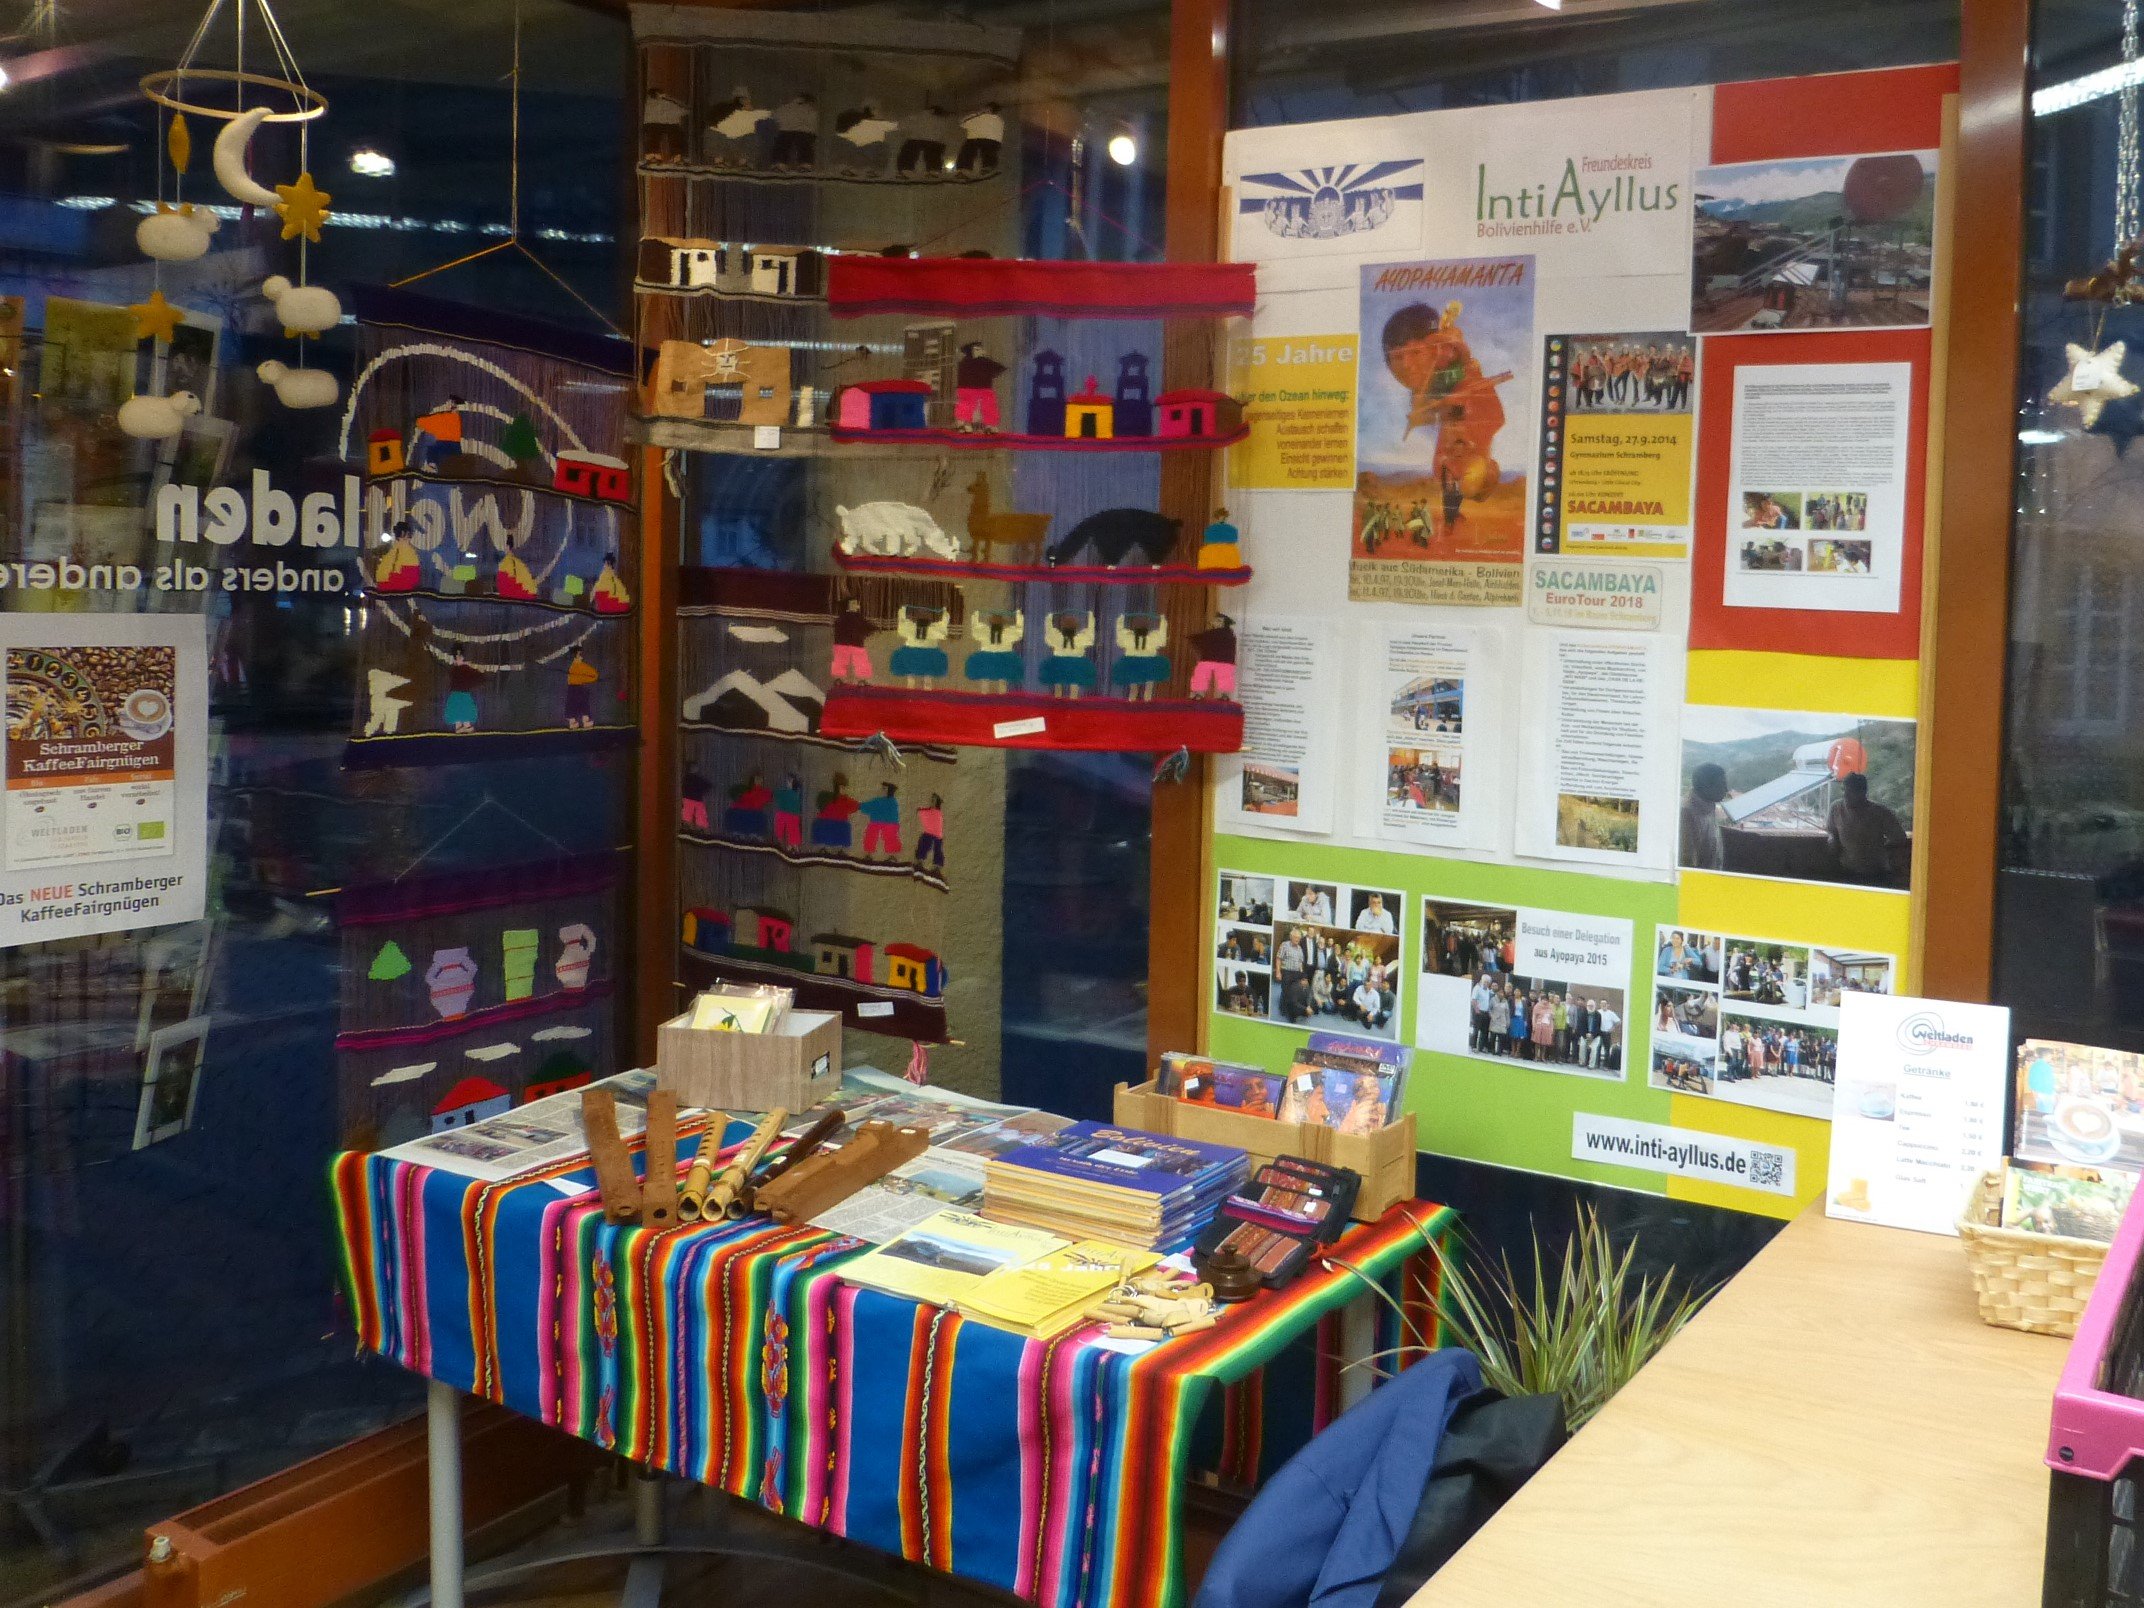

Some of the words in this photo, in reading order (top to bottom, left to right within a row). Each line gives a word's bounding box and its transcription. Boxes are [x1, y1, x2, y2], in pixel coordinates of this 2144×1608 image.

[1582, 153, 1652, 172] Freundeskreis
[1477, 220, 1562, 237] Bolivienhilfe
[1277, 343, 1353, 365] Jahre
[1259, 390, 1277, 402] den
[1279, 389, 1309, 402] Ozean
[1571, 433, 1622, 445] Samstag,
[1626, 435, 1677, 446] 27.9.2014
[1570, 452, 1614, 460] Gymnasium
[1616, 451, 1661, 460] Schramberg
[1568, 500, 1664, 515] SACAMBAYA
[1381, 564, 1398, 572] aus
[1401, 562, 1464, 577] Südamerika
[1477, 566, 1520, 578] Bolivien
[1535, 569, 1656, 594] SACAMBAYA
[1546, 592, 1606, 608] EuroTour
[1610, 596, 1643, 609] 2018
[39, 739, 144, 756] Schramberger
[23, 754, 159, 772] KaffeeFairgnügen
[31, 825, 87, 837] WELTLADEN
[30, 884, 73, 901] NEUE
[78, 874, 183, 898] Schramberger
[21, 893, 160, 923] KaffeeFairgnügen
[1522, 922, 1550, 937] Besuch
[1552, 928, 1573, 940] einer
[1575, 929, 1621, 946] Delegation
[1534, 948, 1548, 958] aus
[1550, 948, 1584, 965] Ayopaya
[1587, 952, 1607, 965] 2015
[1912, 1023, 1973, 1045] Weltladen
[1904, 1064, 1951, 1079] Getränke
[1587, 1132, 1746, 1174] www.inti-ayllus.de
